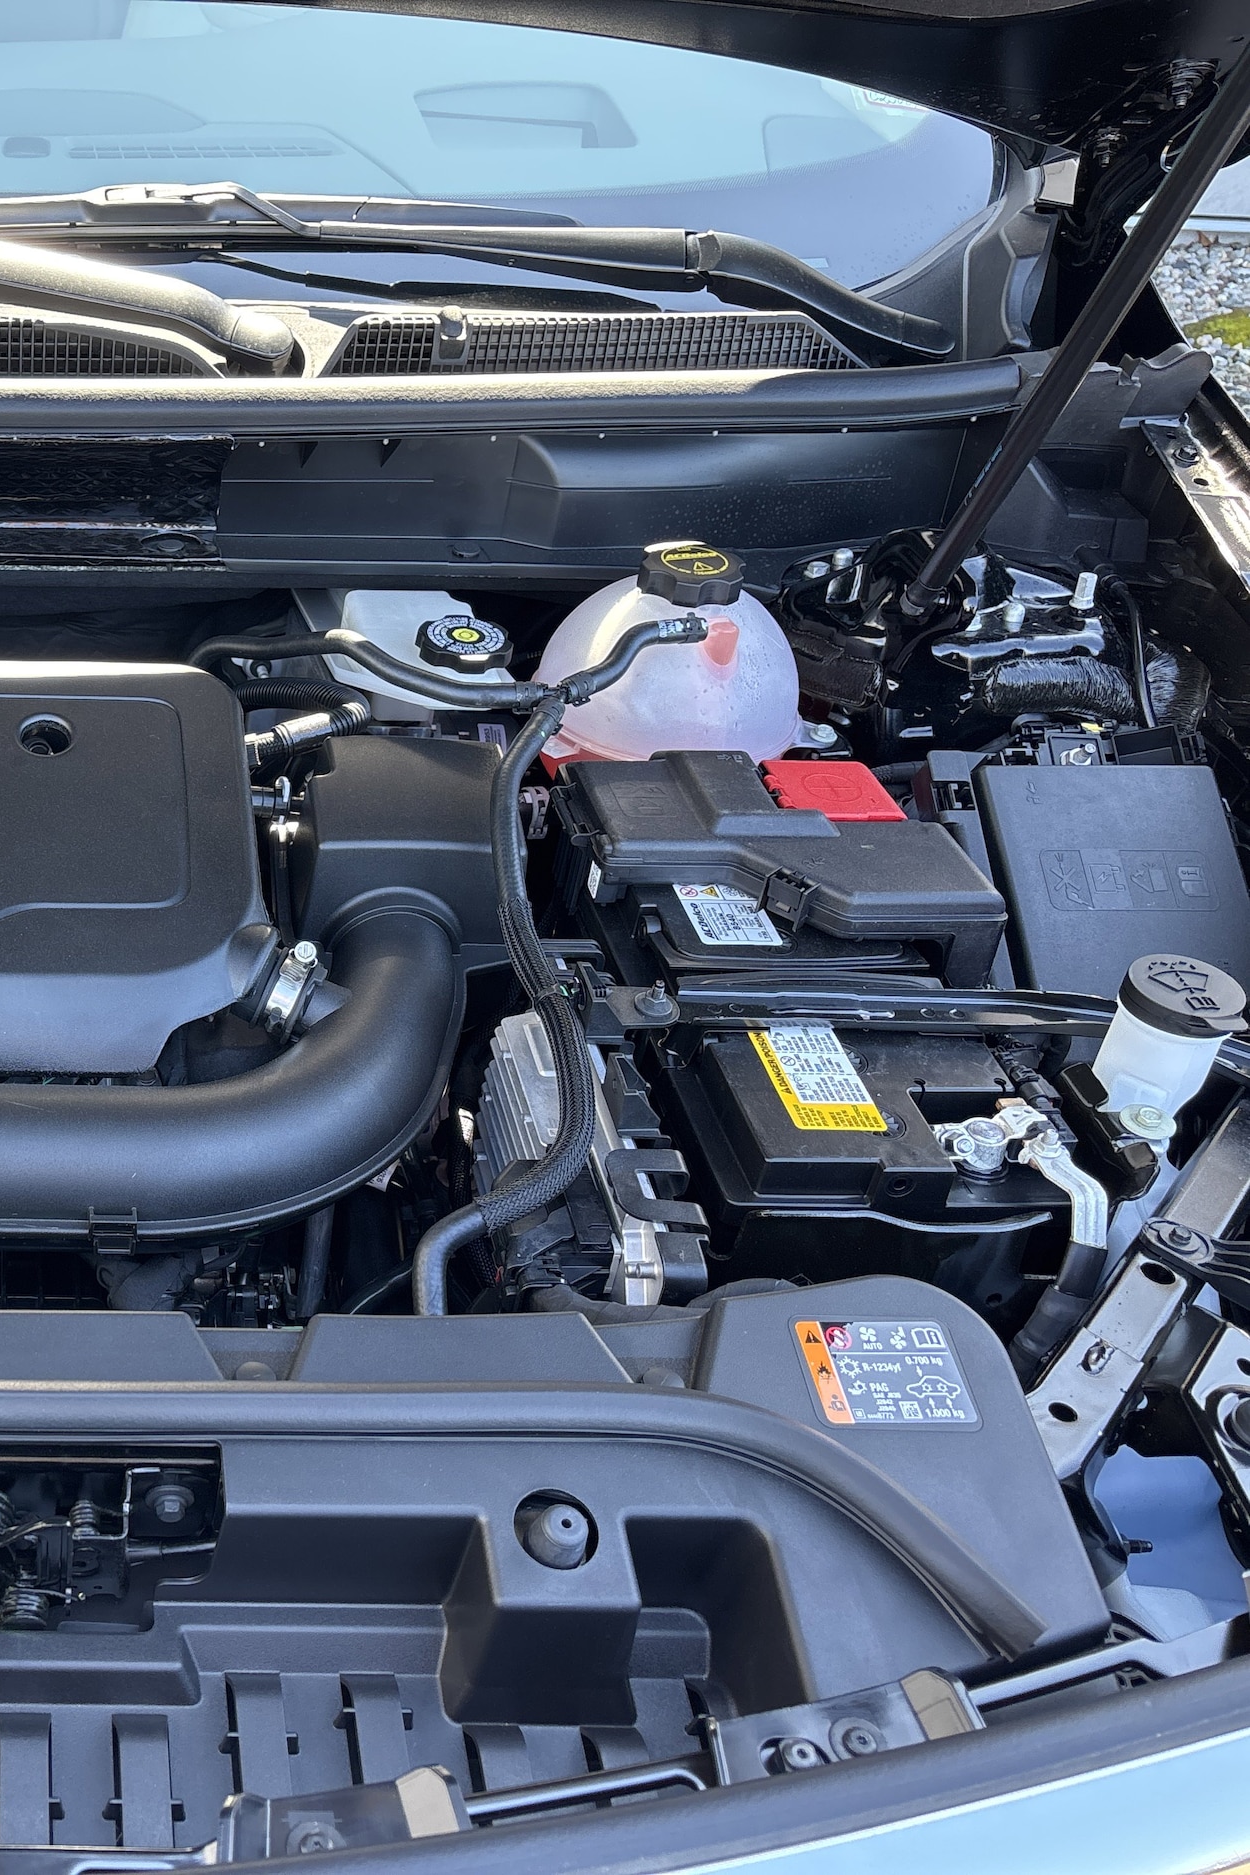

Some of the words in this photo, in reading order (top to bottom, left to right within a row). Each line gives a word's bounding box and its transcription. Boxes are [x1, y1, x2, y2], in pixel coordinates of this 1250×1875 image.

[665, 552, 717, 561] ACDelco
[690, 902, 716, 940] ACDelco
[863, 1342, 883, 1350] AUTO
[905, 1356, 930, 1365] 0.700
[930, 1356, 944, 1367] kg
[869, 1382, 890, 1392] PAG
[925, 1408, 952, 1418] 1.000
[952, 1408, 966, 1420] kg
